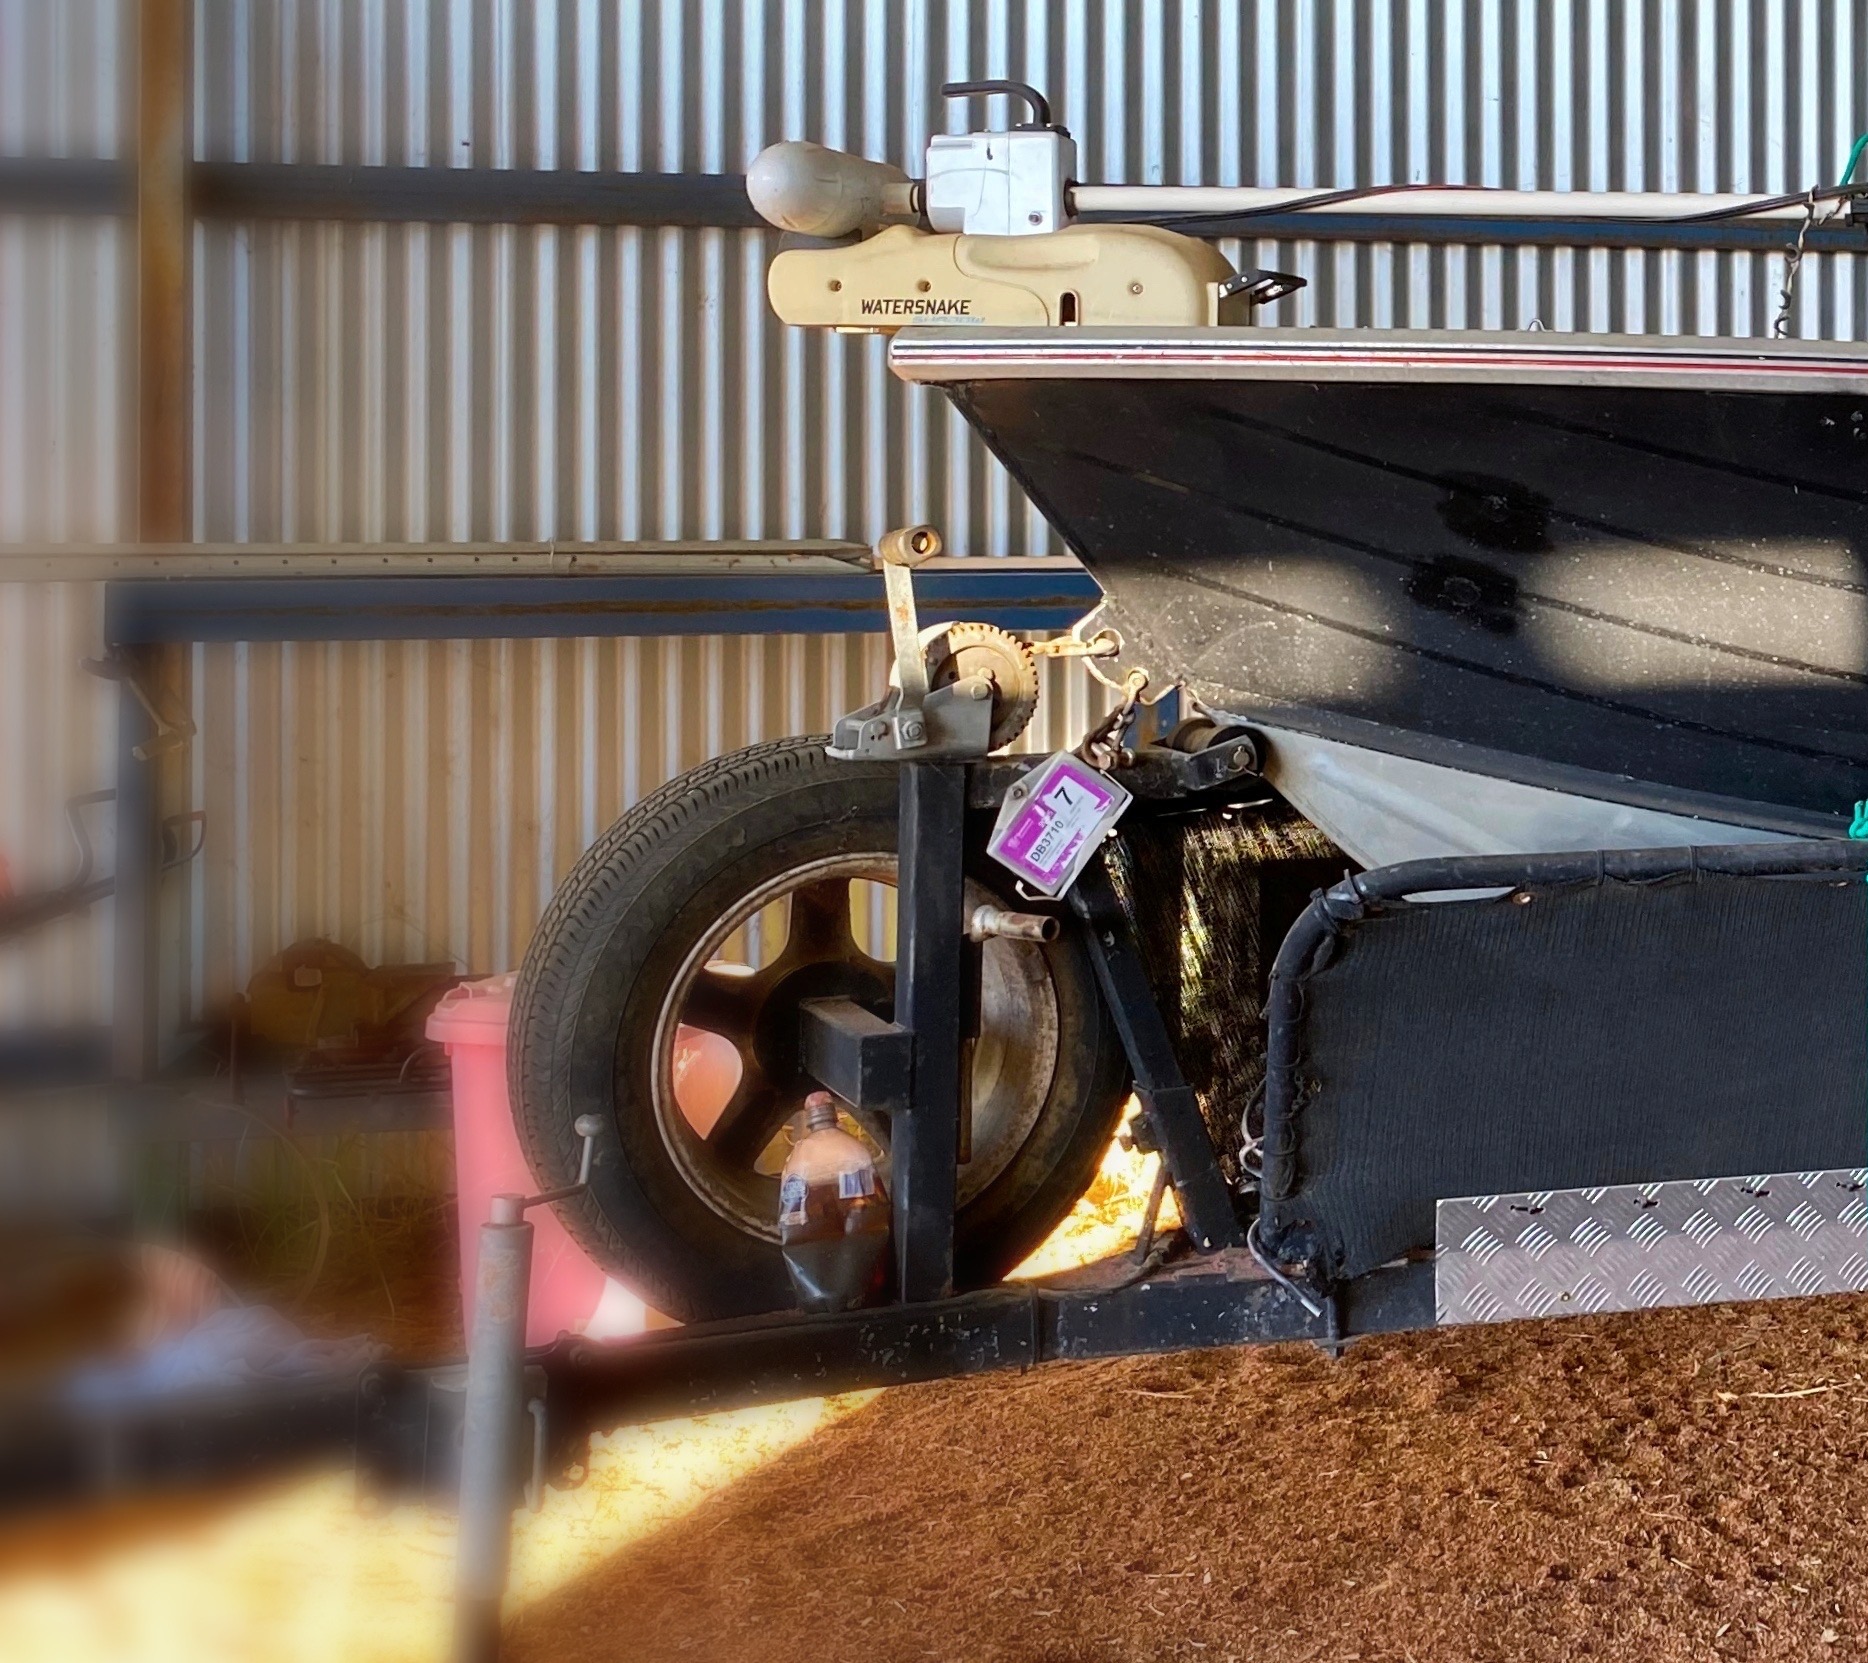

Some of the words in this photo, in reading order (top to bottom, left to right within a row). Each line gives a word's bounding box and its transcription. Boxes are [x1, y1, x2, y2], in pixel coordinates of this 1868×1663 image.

[861, 299, 972, 315] WATERSNAKE
[1054, 786, 1073, 806] 7
[1030, 820, 1064, 863] DB3710
